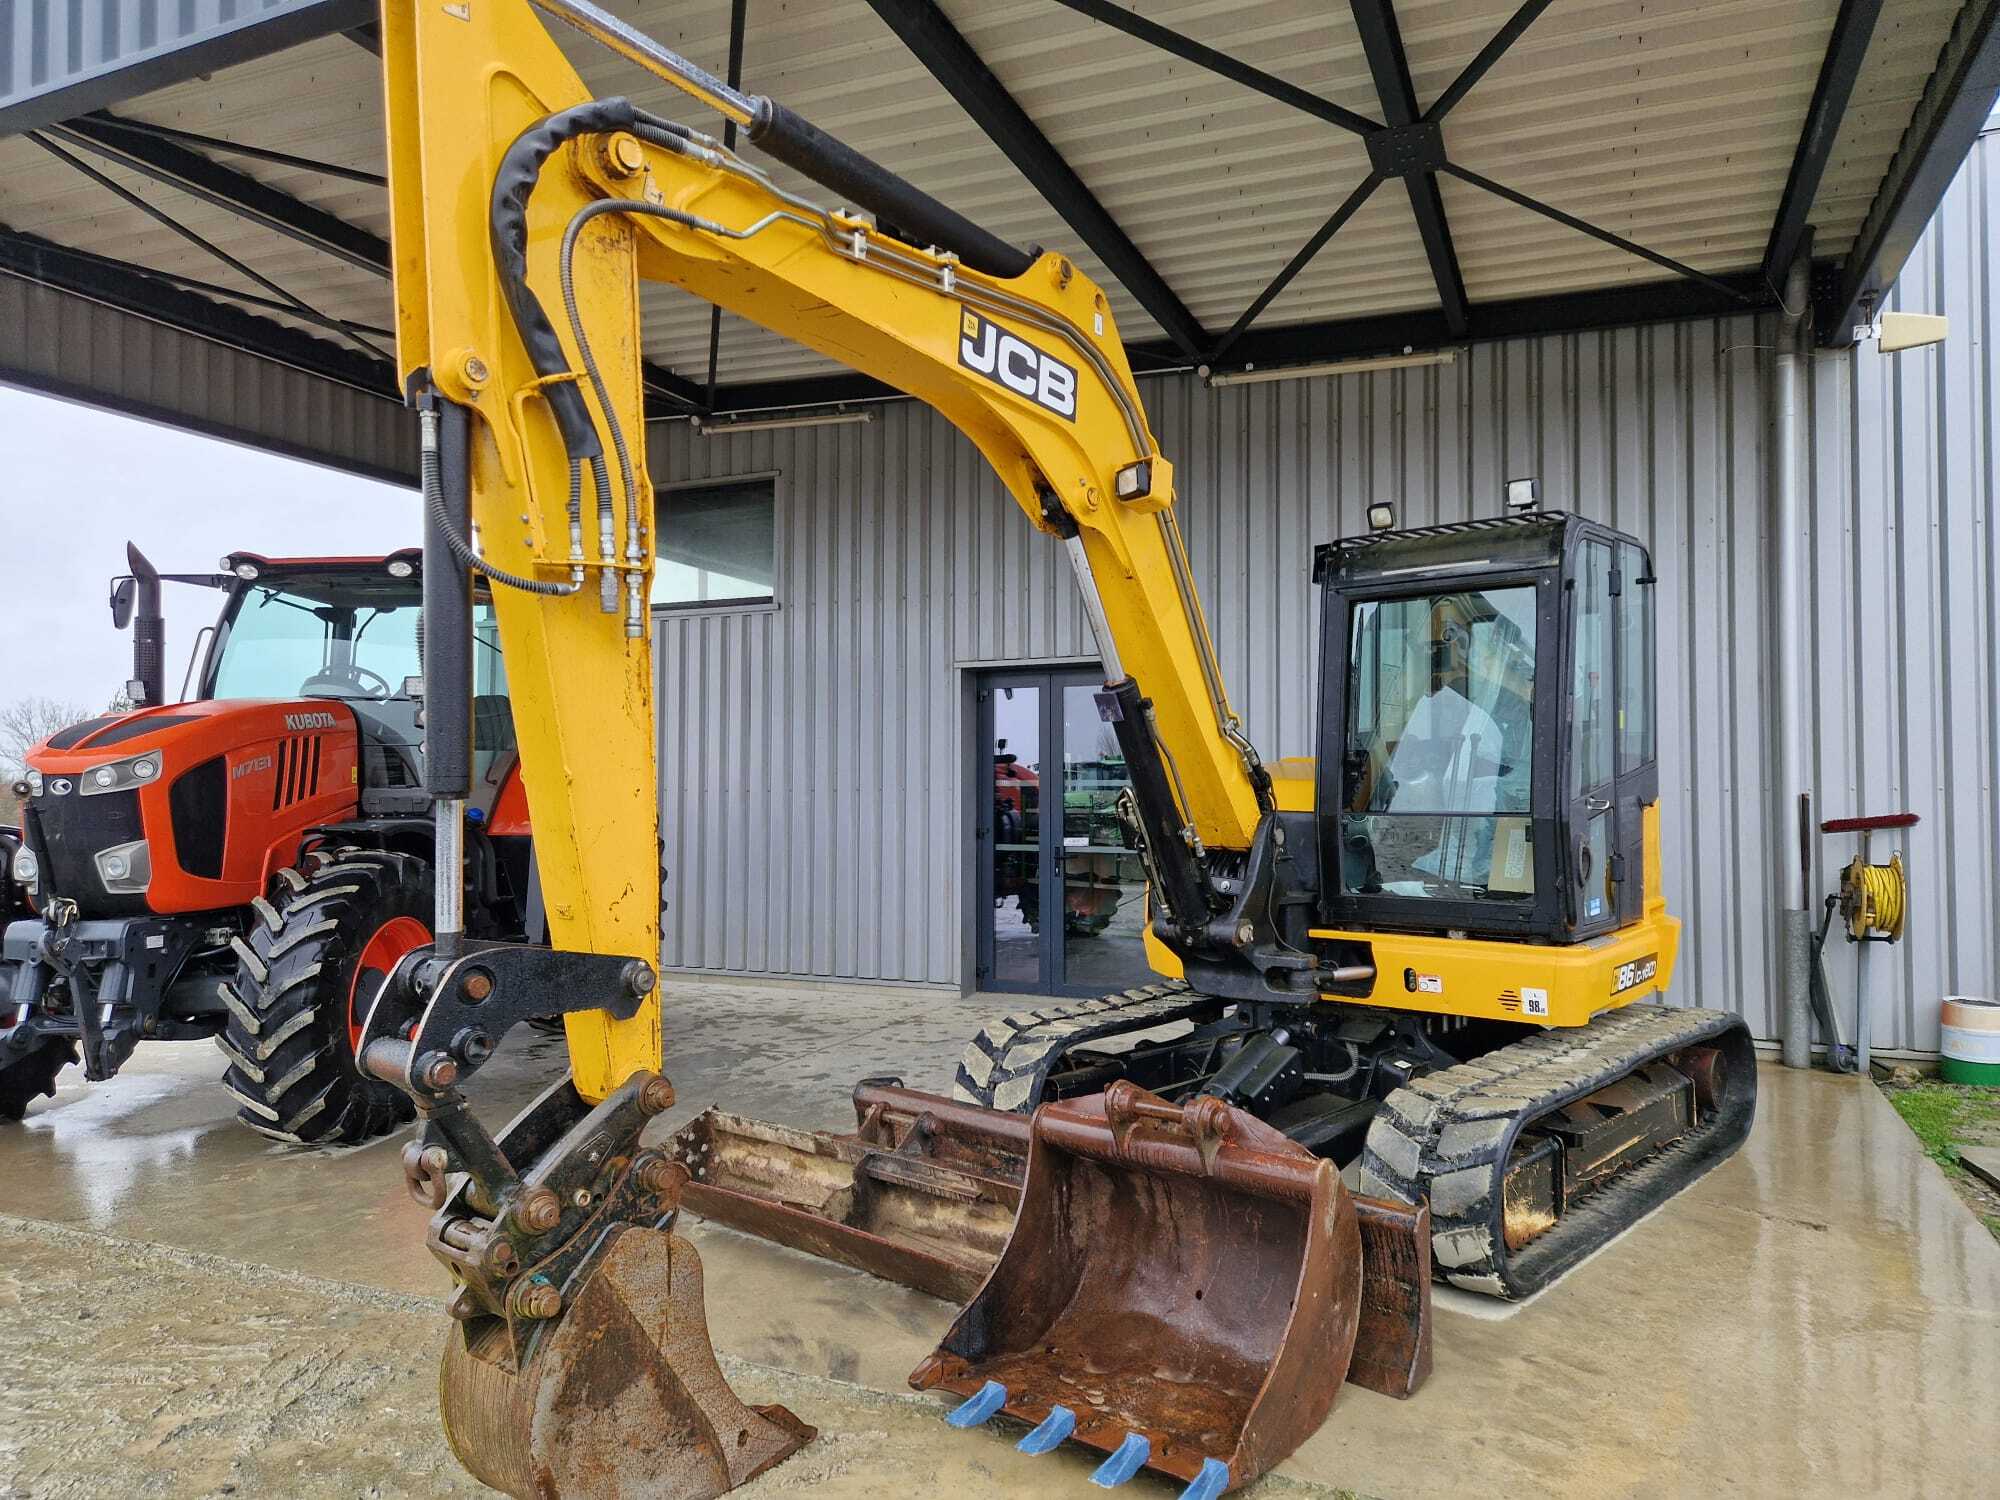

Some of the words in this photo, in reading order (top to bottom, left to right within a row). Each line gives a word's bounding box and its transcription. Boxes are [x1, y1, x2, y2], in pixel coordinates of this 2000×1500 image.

[961, 323, 1075, 416] JCB
[284, 712, 337, 731] KUBOTA
[1528, 999, 1541, 1013] 98
